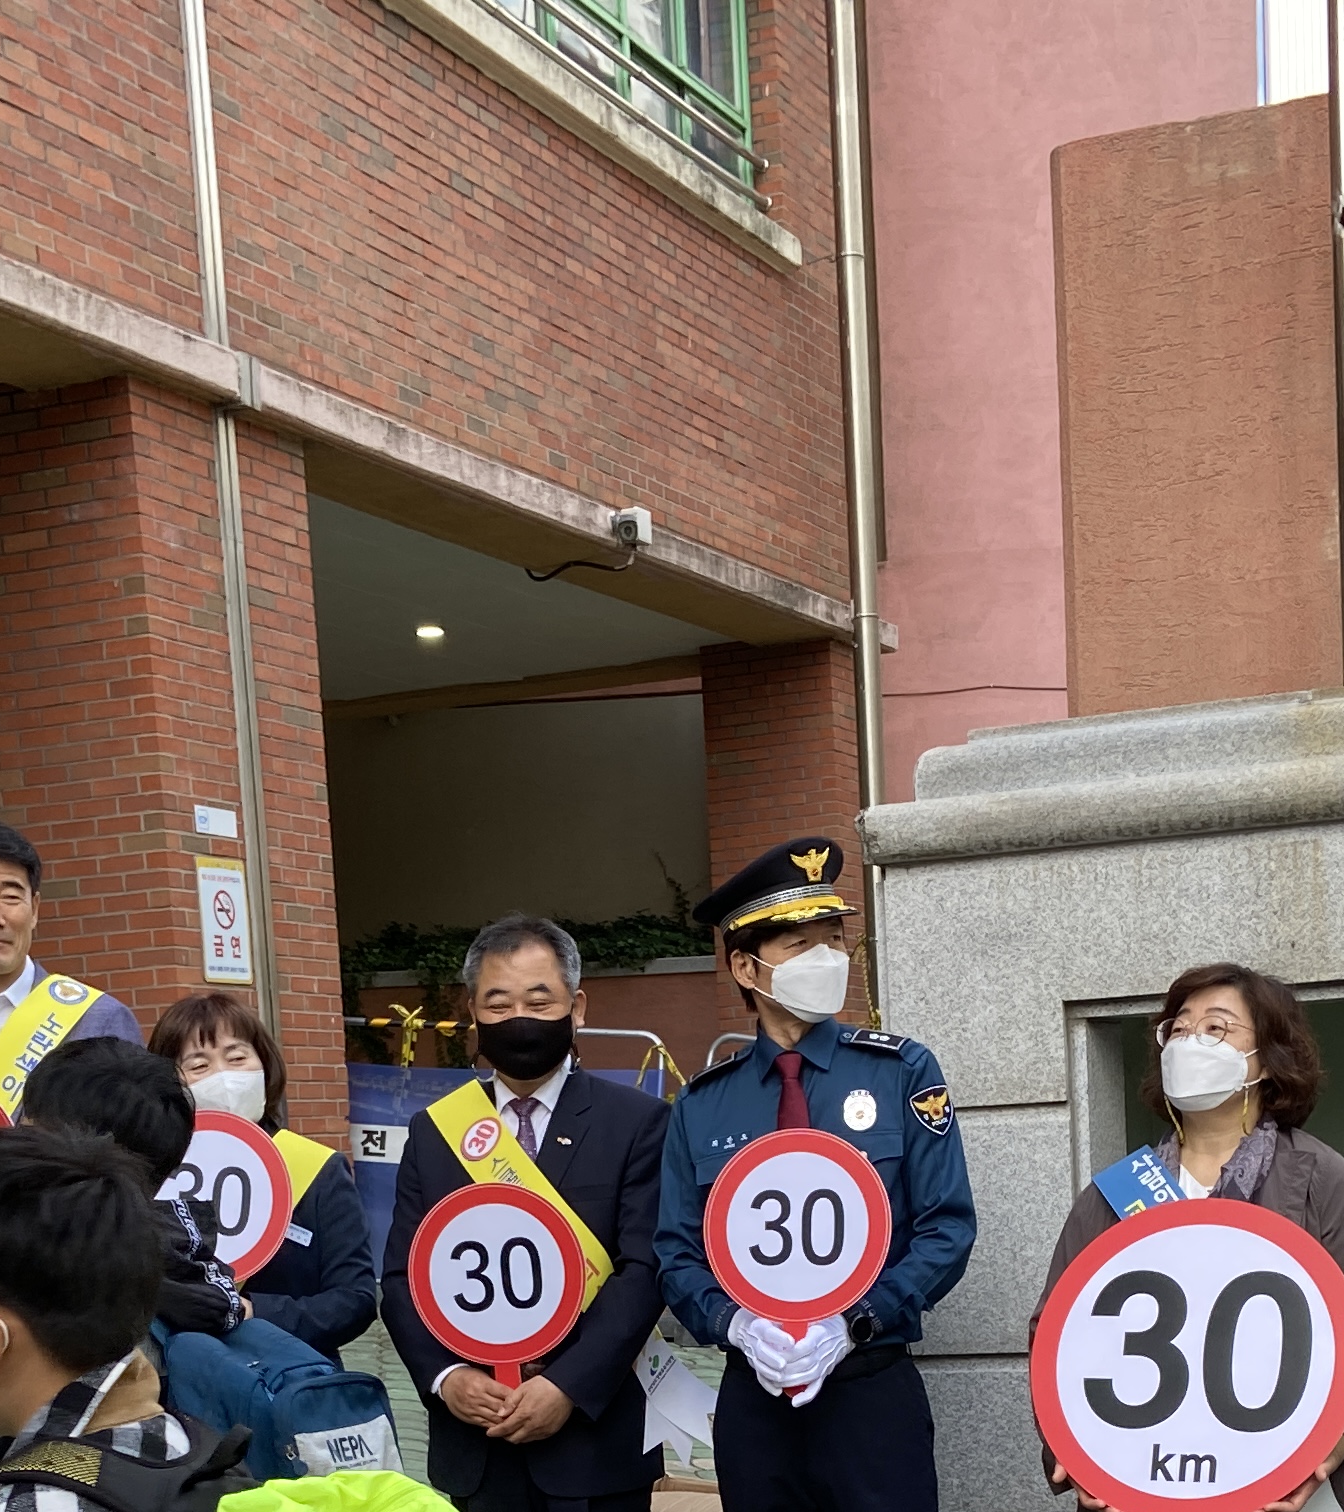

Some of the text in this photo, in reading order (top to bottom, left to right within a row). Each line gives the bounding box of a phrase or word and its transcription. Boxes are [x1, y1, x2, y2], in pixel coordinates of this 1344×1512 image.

[360, 1129, 387, 1157] 전
[467, 1123, 496, 1154] 30
[1131, 1153, 1180, 1204] 사람이
[749, 1188, 846, 1267] 30
[450, 1236, 544, 1314] 30
[1083, 1269, 1313, 1433] 30
[326, 1434, 373, 1463] NEPA
[1150, 1443, 1218, 1484] km
